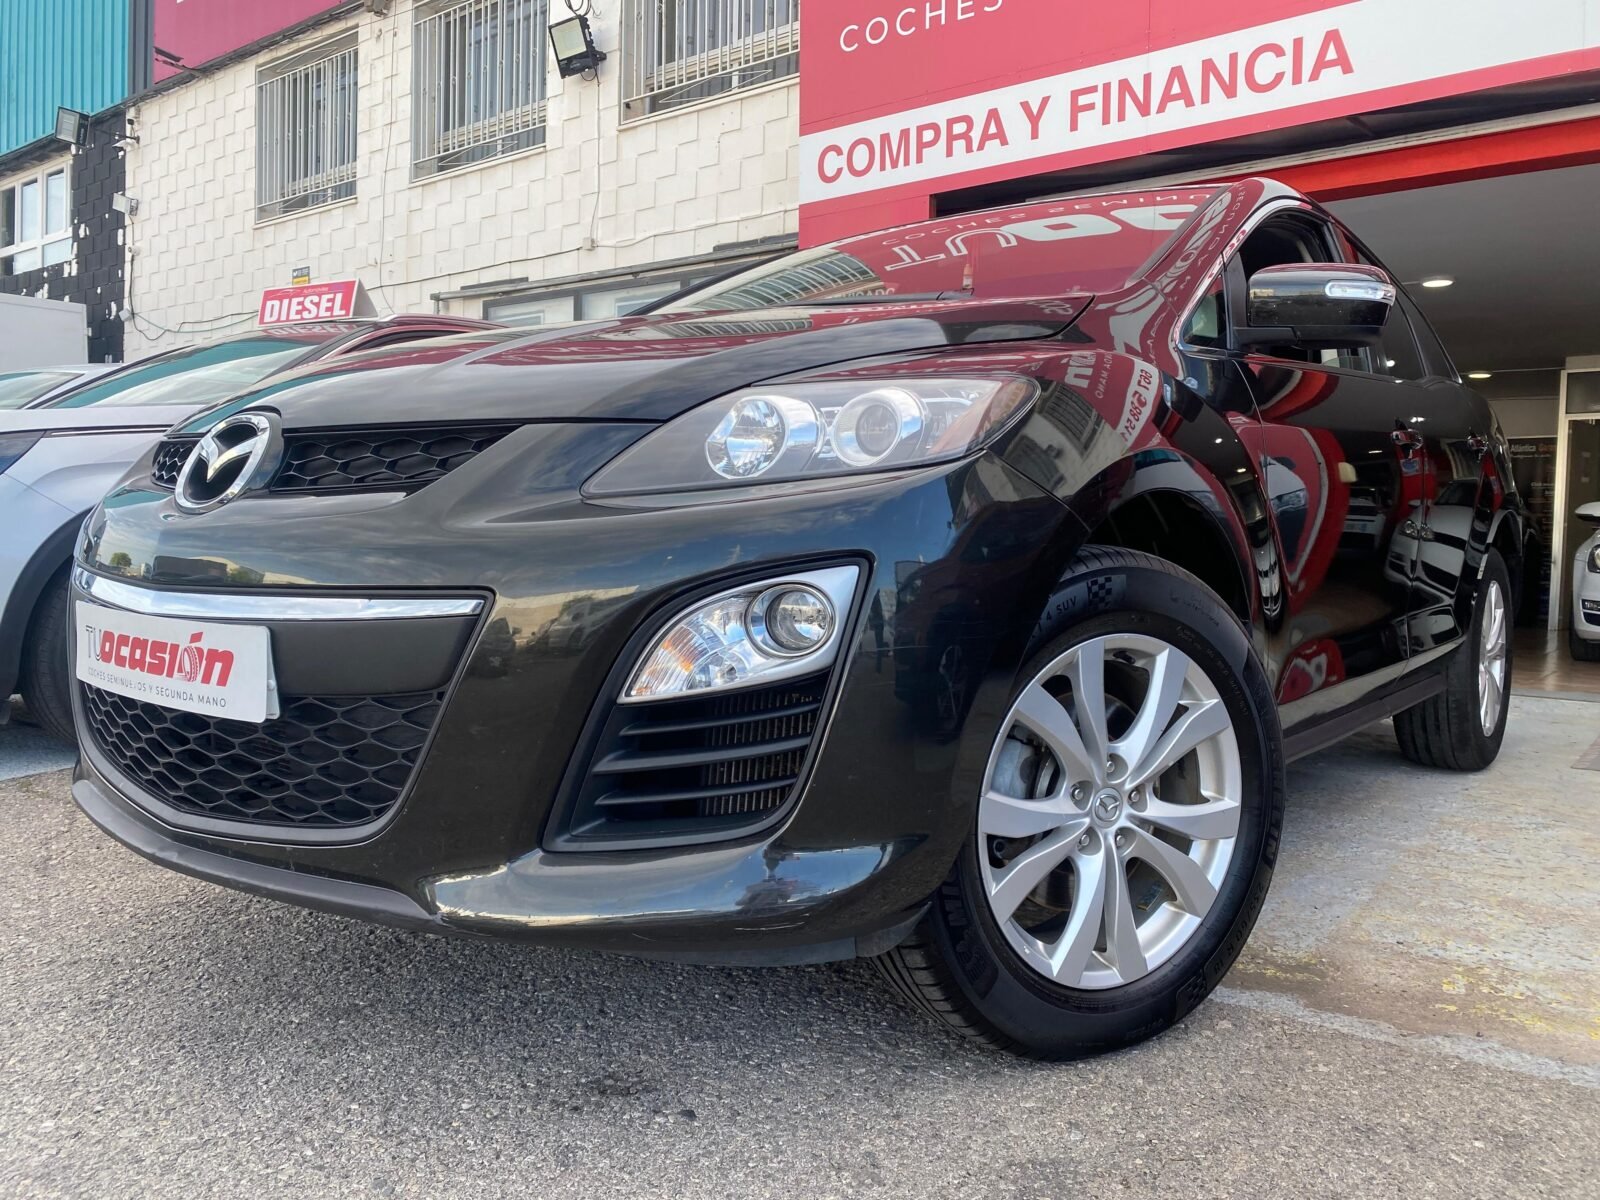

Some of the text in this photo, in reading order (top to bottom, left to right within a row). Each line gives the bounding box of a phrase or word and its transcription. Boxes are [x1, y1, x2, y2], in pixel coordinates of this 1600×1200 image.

[818, 28, 1355, 184] COMPRA Y FINANCIA
[263, 292, 346, 323] DIESEL
[1056, 595, 1077, 615] SUV
[155, 686, 194, 703] SEGUNDA
[197, 695, 227, 708] MANO
